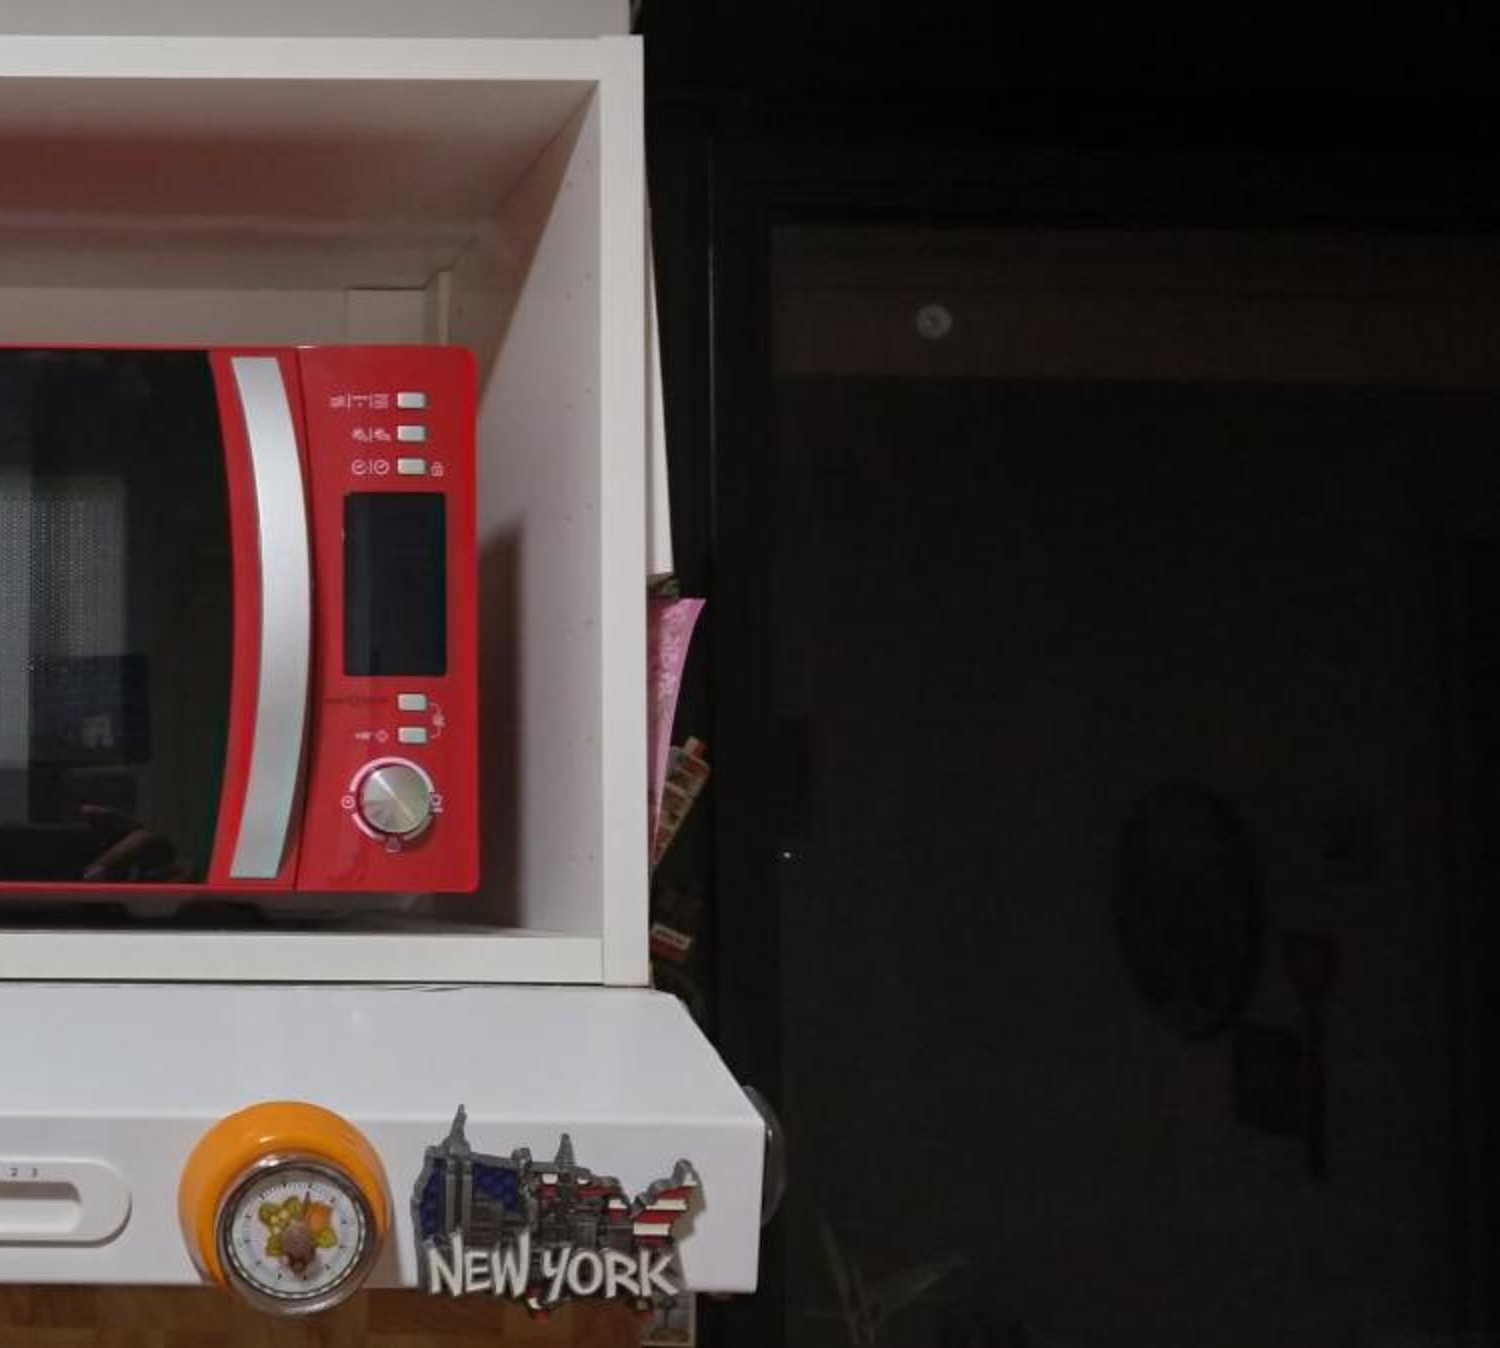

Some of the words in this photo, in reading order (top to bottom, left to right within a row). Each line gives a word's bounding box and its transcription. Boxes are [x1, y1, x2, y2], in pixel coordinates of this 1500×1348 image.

[10, 1165, 19, 1177] 2
[427, 1229, 531, 1297] NEW
[542, 1247, 679, 1301] YORK
